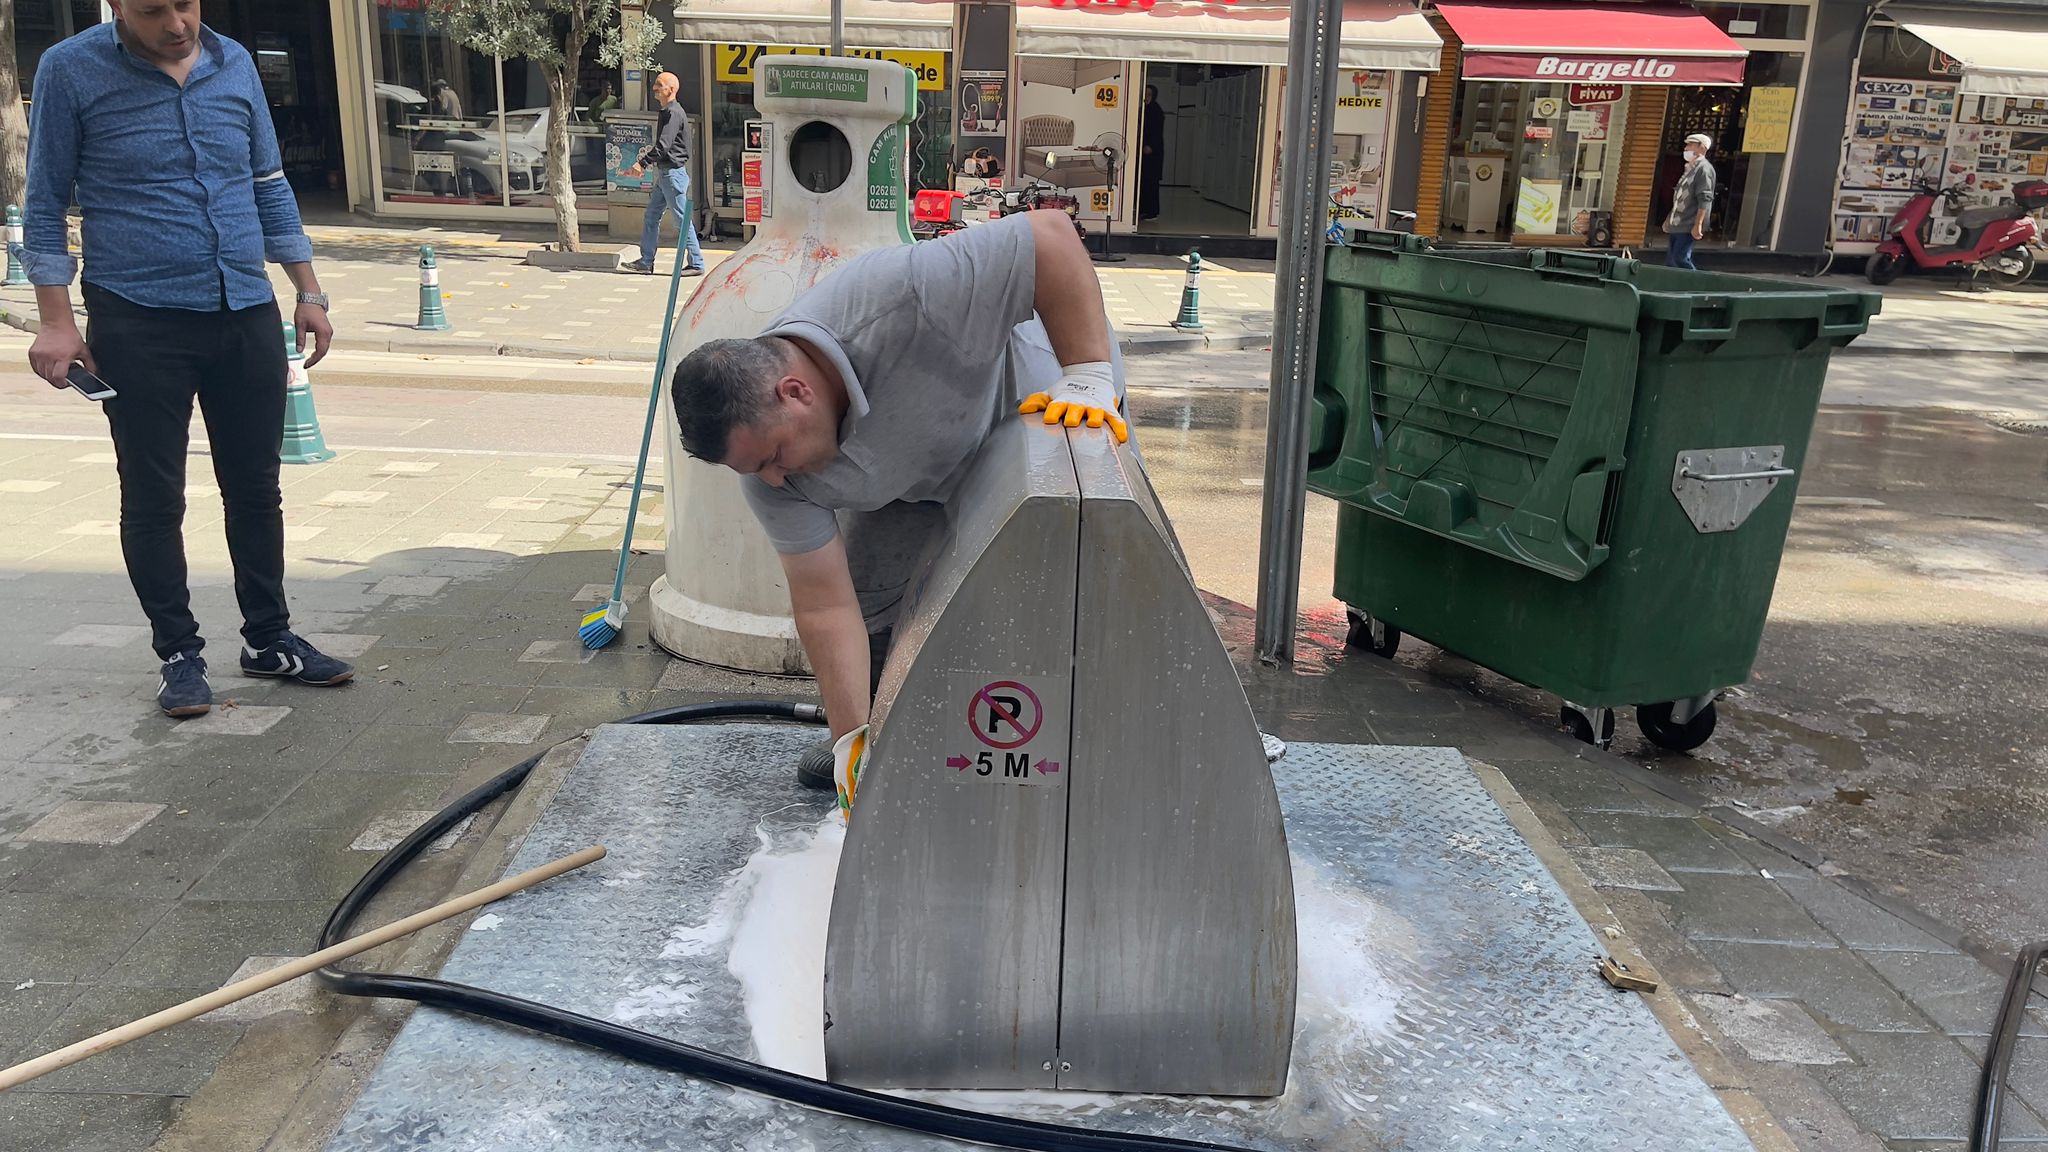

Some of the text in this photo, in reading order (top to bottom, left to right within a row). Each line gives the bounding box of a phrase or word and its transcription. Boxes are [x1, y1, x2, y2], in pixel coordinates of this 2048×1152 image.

[905, 62, 938, 82] de
[1535, 56, 1676, 81] Bargello
[782, 71, 866, 83] SADECE CAM AMBALAJ
[790, 80, 824, 90] ATIKLARI
[1579, 87, 1615, 100] FİYAT
[1338, 97, 1382, 107] HEDİYE
[869, 140, 884, 165] CAM
[869, 184, 889, 196] 0262
[869, 198, 889, 210] 0262
[975, 751, 1030, 779] 5 M
